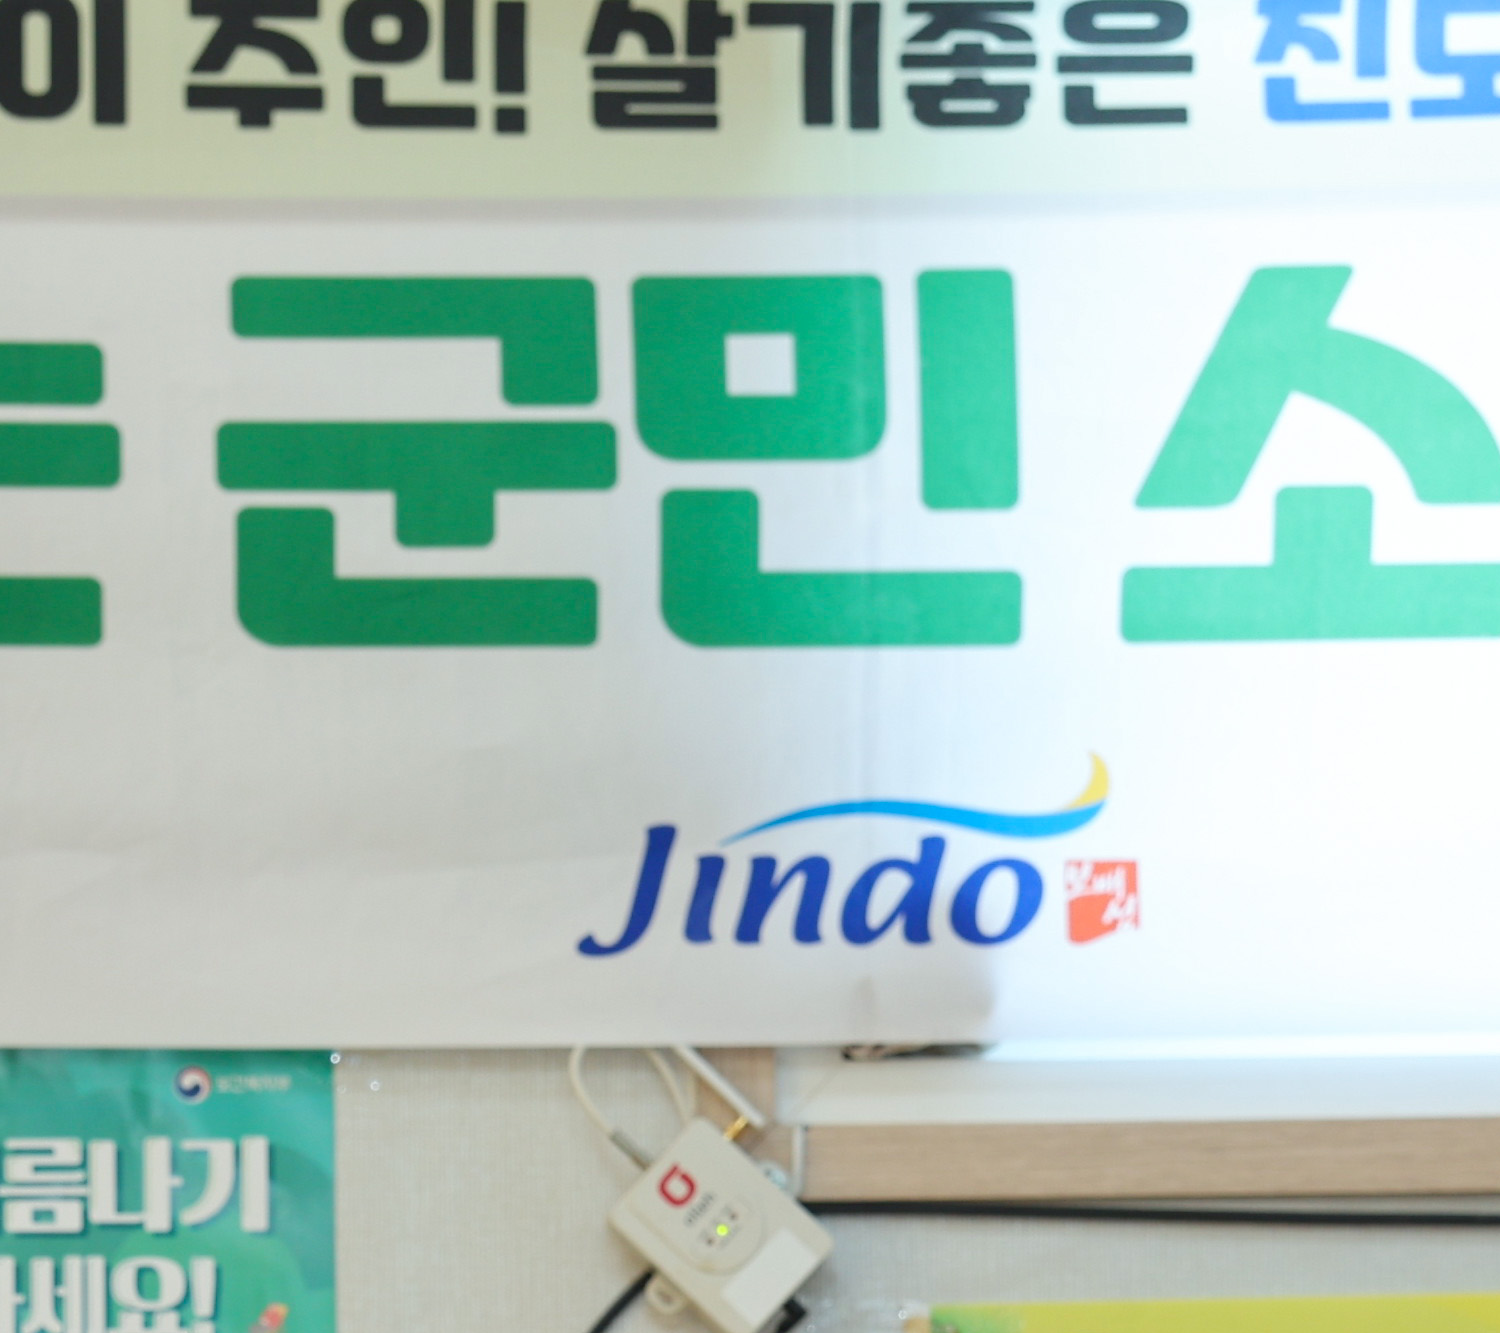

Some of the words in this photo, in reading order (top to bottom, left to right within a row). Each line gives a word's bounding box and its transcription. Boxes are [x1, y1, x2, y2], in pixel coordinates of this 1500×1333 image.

[185, 0, 528, 134] 주인!
[584, 0, 1194, 131] 살기좋은
[216, 268, 1023, 651] 군민
[577, 822, 1045, 957] Jindo
